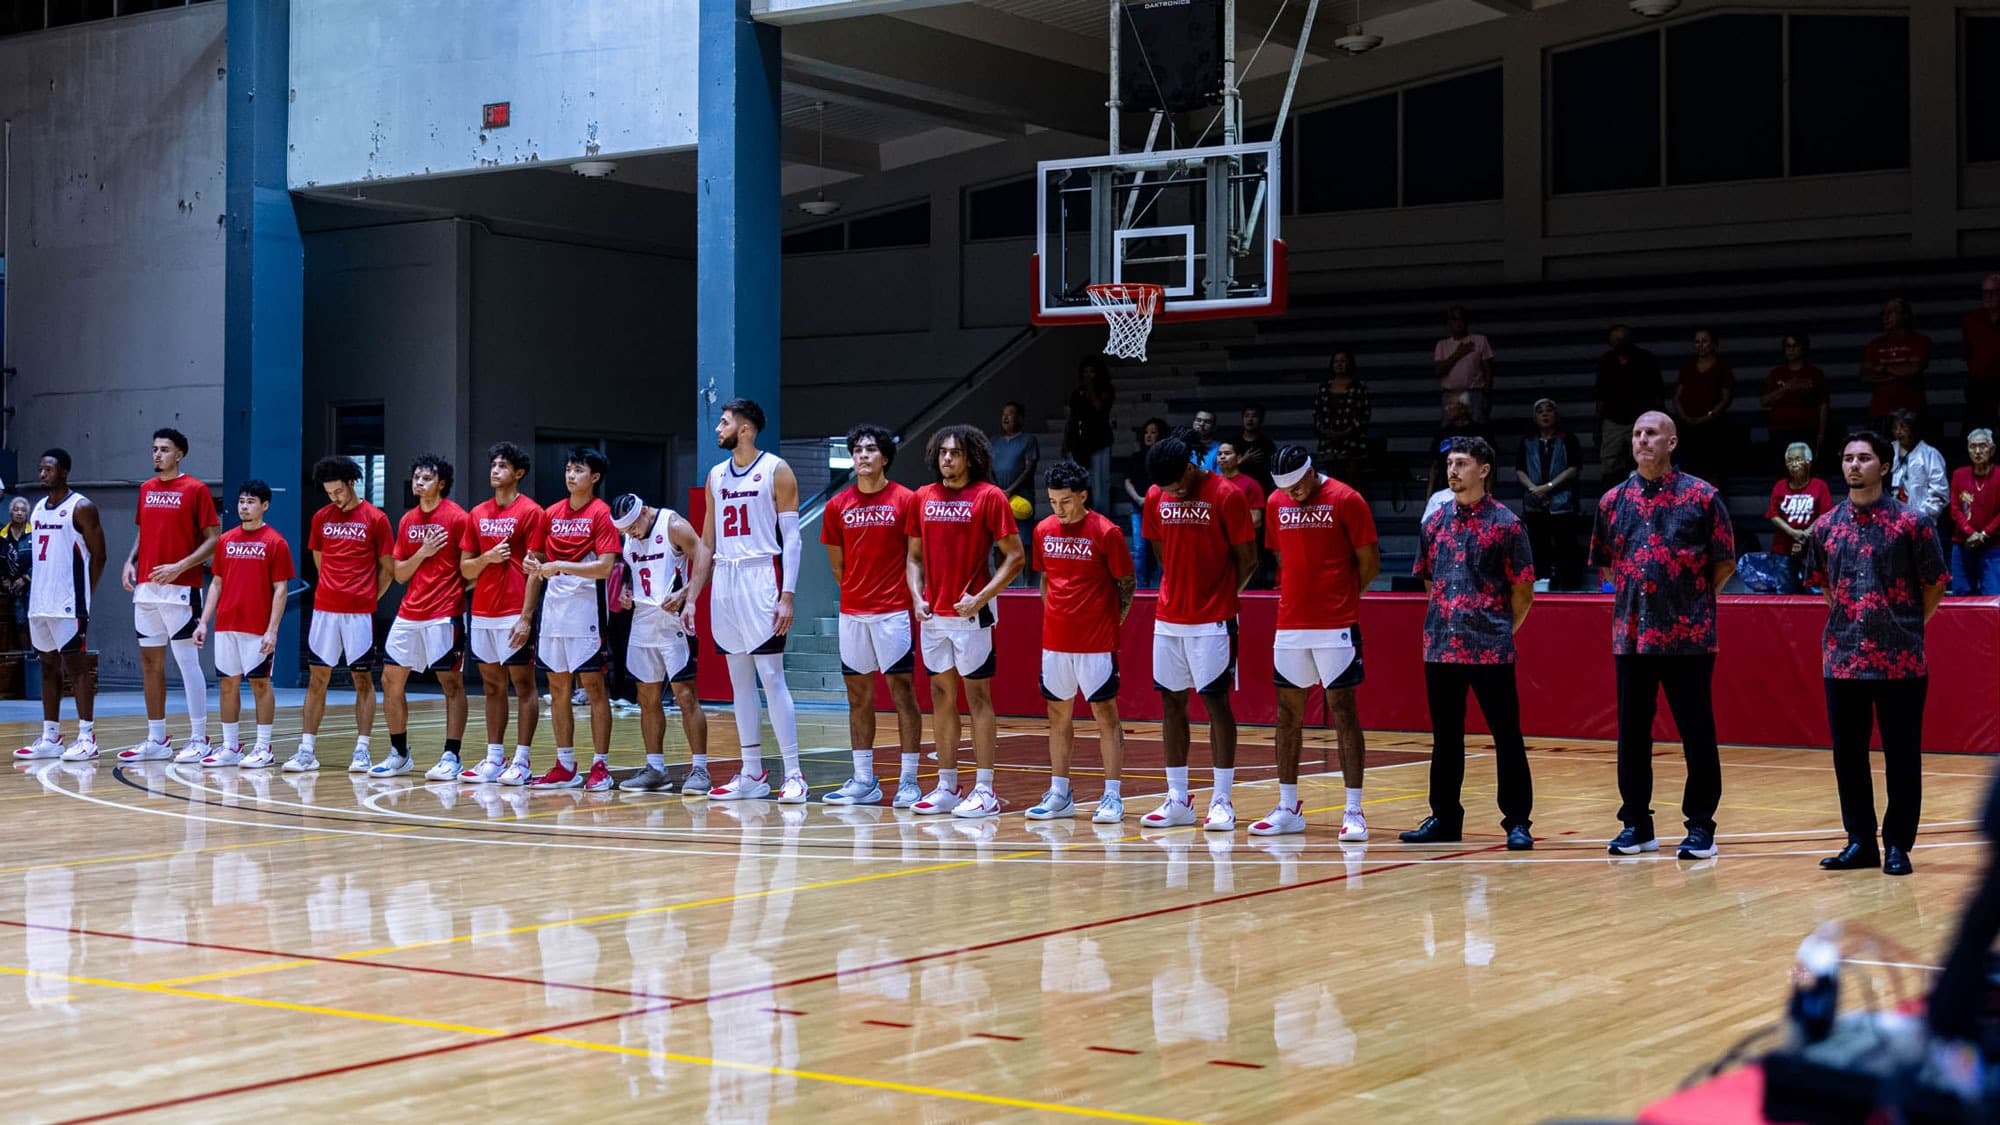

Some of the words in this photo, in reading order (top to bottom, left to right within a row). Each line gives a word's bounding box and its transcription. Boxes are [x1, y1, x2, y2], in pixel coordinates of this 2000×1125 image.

[723, 503, 751, 538] 21
[38, 535, 50, 561] 7
[639, 567, 651, 597] 6
